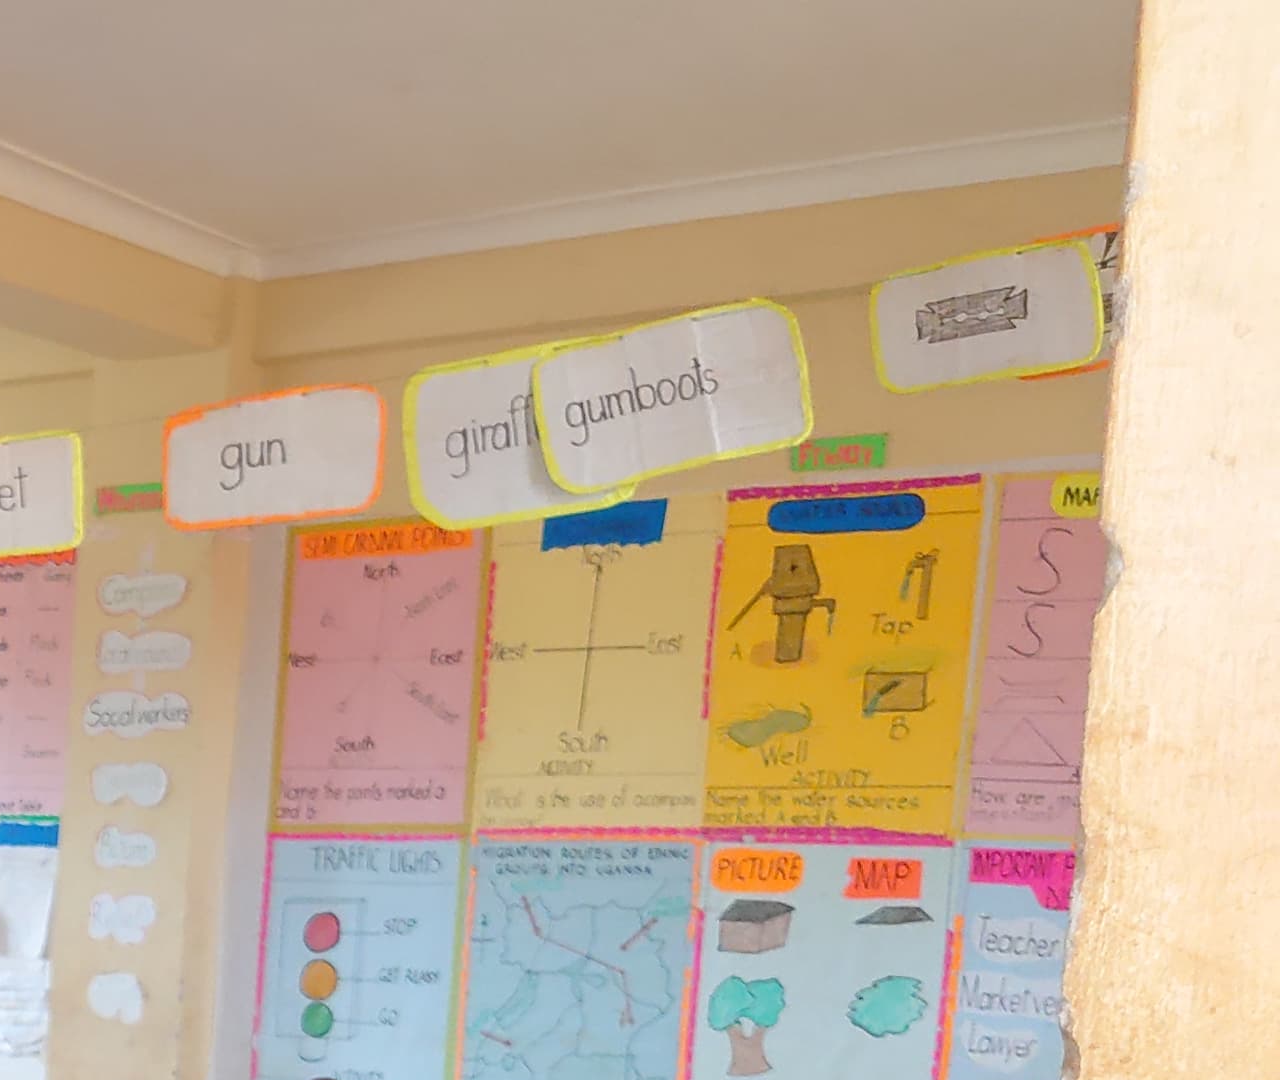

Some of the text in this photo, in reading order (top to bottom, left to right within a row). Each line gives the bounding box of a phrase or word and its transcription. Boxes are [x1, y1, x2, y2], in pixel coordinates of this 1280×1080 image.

[564, 358, 719, 447] gumboots
[444, 391, 540, 480] giraff
[220, 436, 288, 491] gun
[871, 612, 915, 643] Tap
[729, 642, 744, 661] A
[760, 739, 809, 767] Well
[706, 788, 921, 812] Name the water sources
[312, 846, 444, 875] TRAFFIC LIGHTS
[716, 857, 802, 883] PICTURE
[854, 860, 913, 891] MAP
[978, 914, 1060, 958] Teacher
[968, 1022, 1037, 1063] Lawyer
